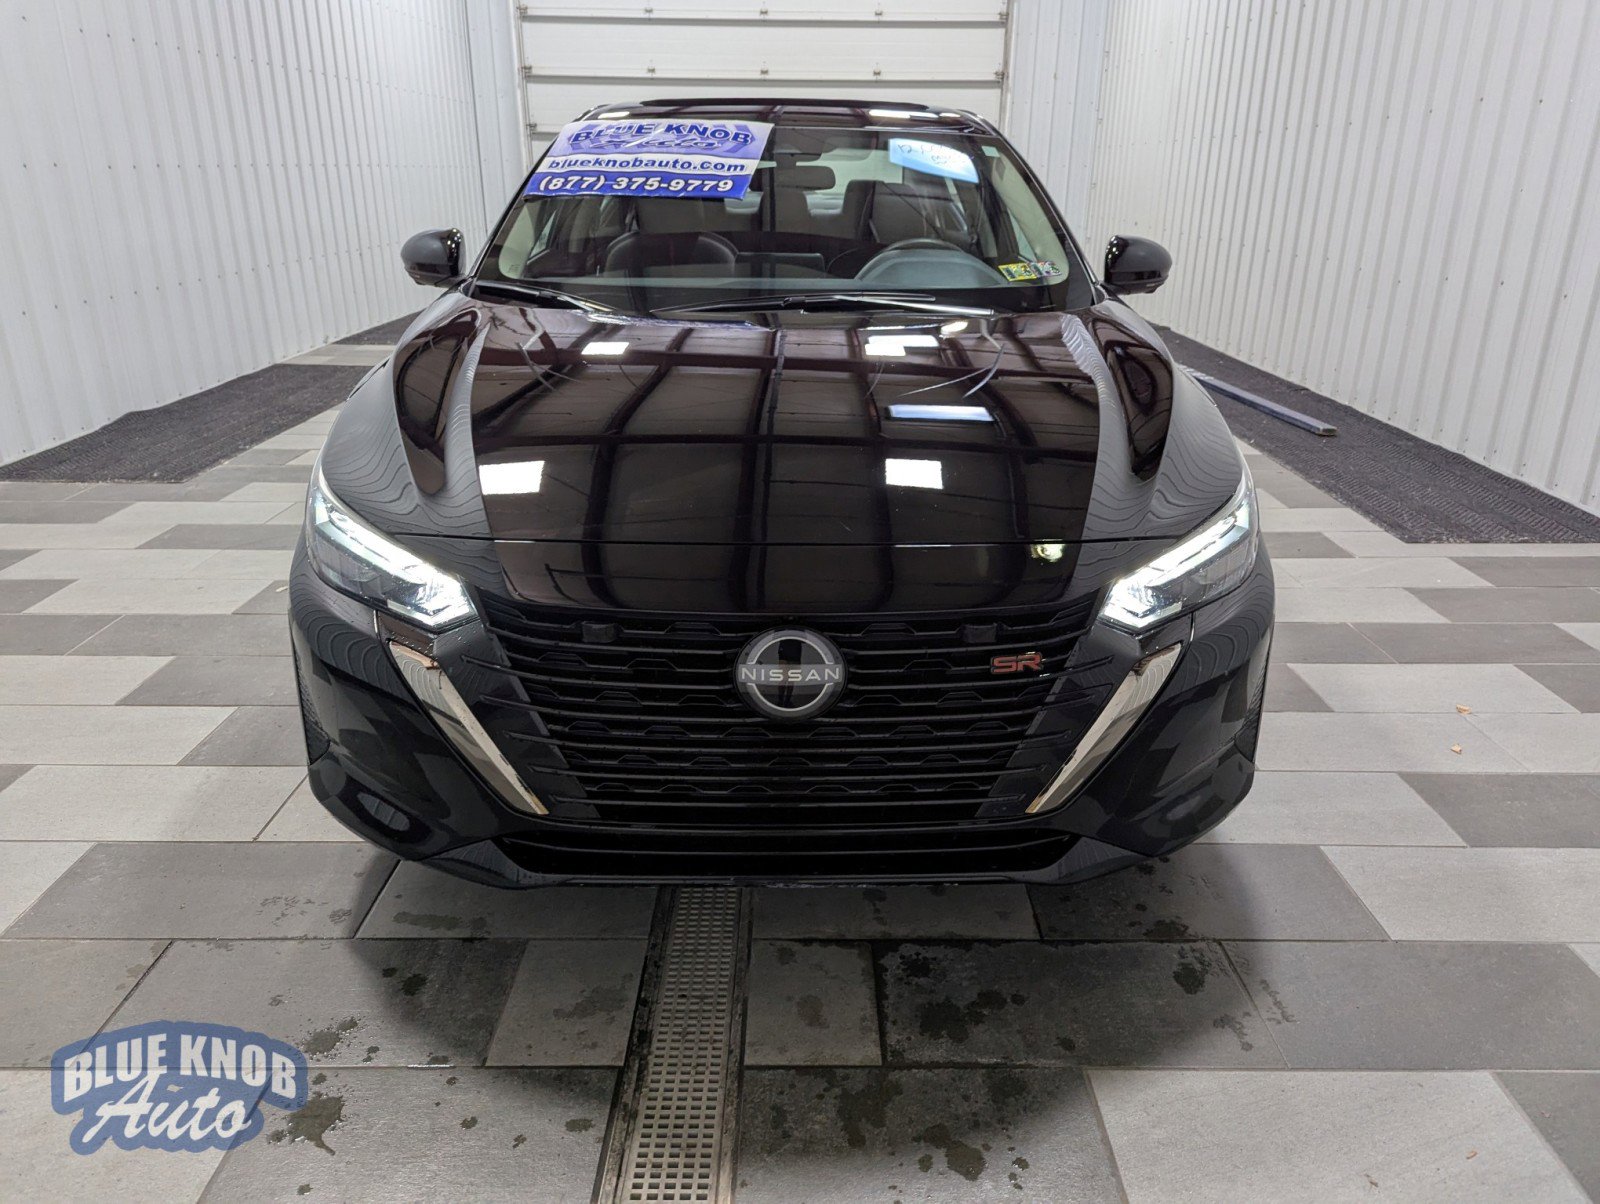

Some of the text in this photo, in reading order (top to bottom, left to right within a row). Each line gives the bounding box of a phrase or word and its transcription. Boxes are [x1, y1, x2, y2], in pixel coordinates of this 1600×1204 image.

[570, 122, 752, 146] BLUE KNOB
[549, 157, 746, 173] blueknobauto.com
[539, 175, 733, 193] (877) 375-9779
[991, 652, 1042, 674] SR
[740, 666, 840, 682] NISSAN
